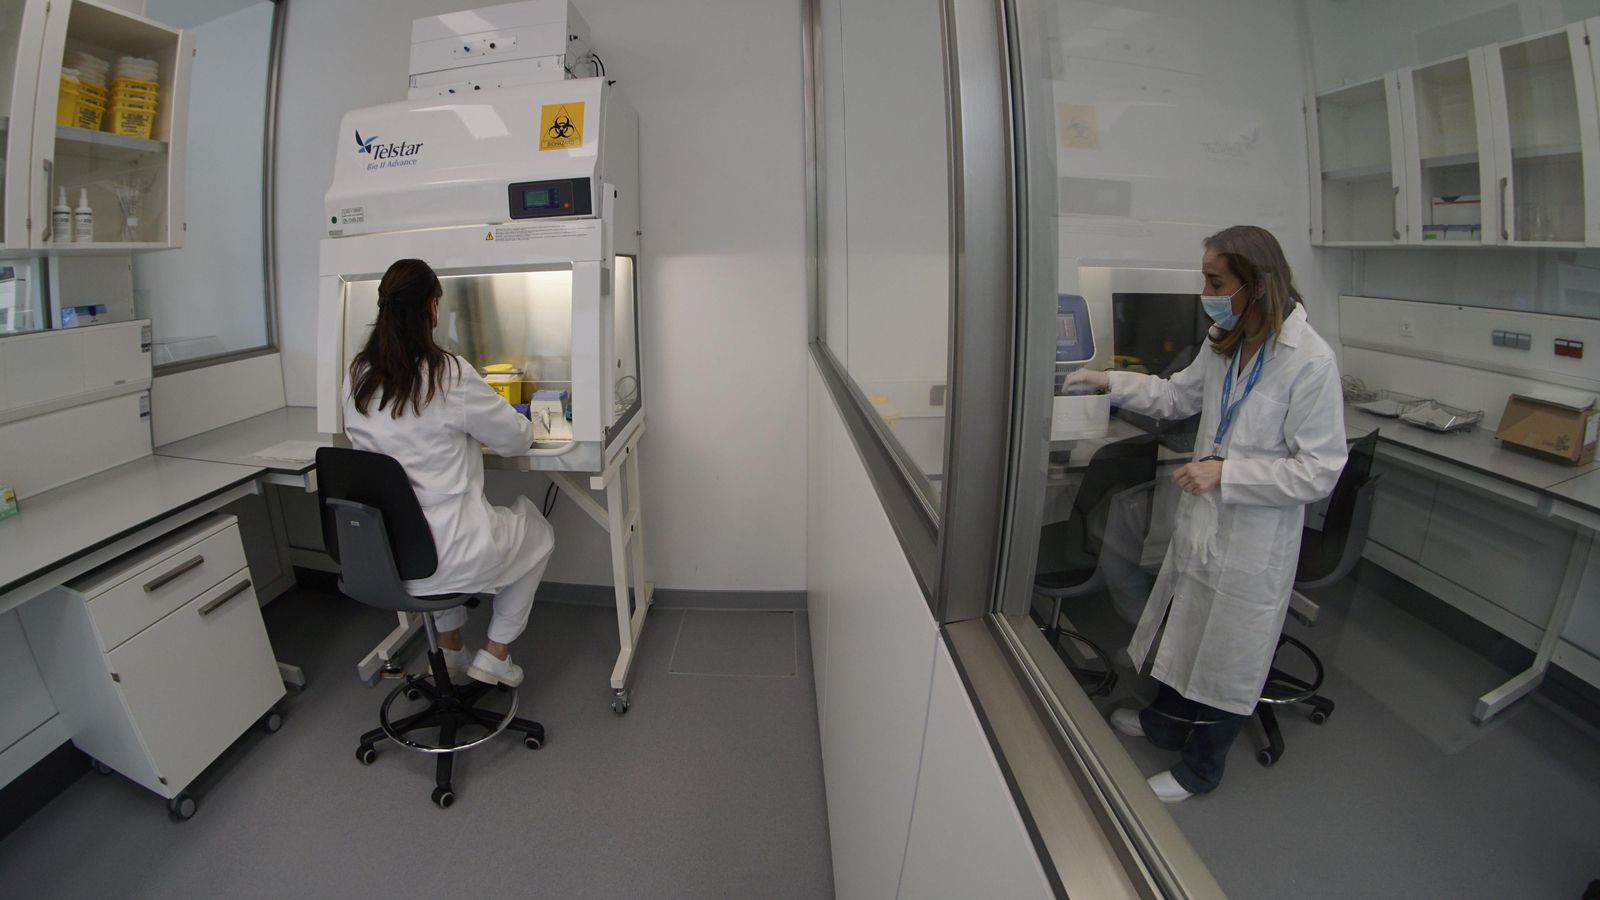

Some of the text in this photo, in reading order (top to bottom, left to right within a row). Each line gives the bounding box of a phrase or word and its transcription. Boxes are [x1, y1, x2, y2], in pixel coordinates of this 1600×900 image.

[373, 141, 423, 160] Telstar
[367, 162, 378, 171] Bio
[387, 159, 417, 168] Advance
